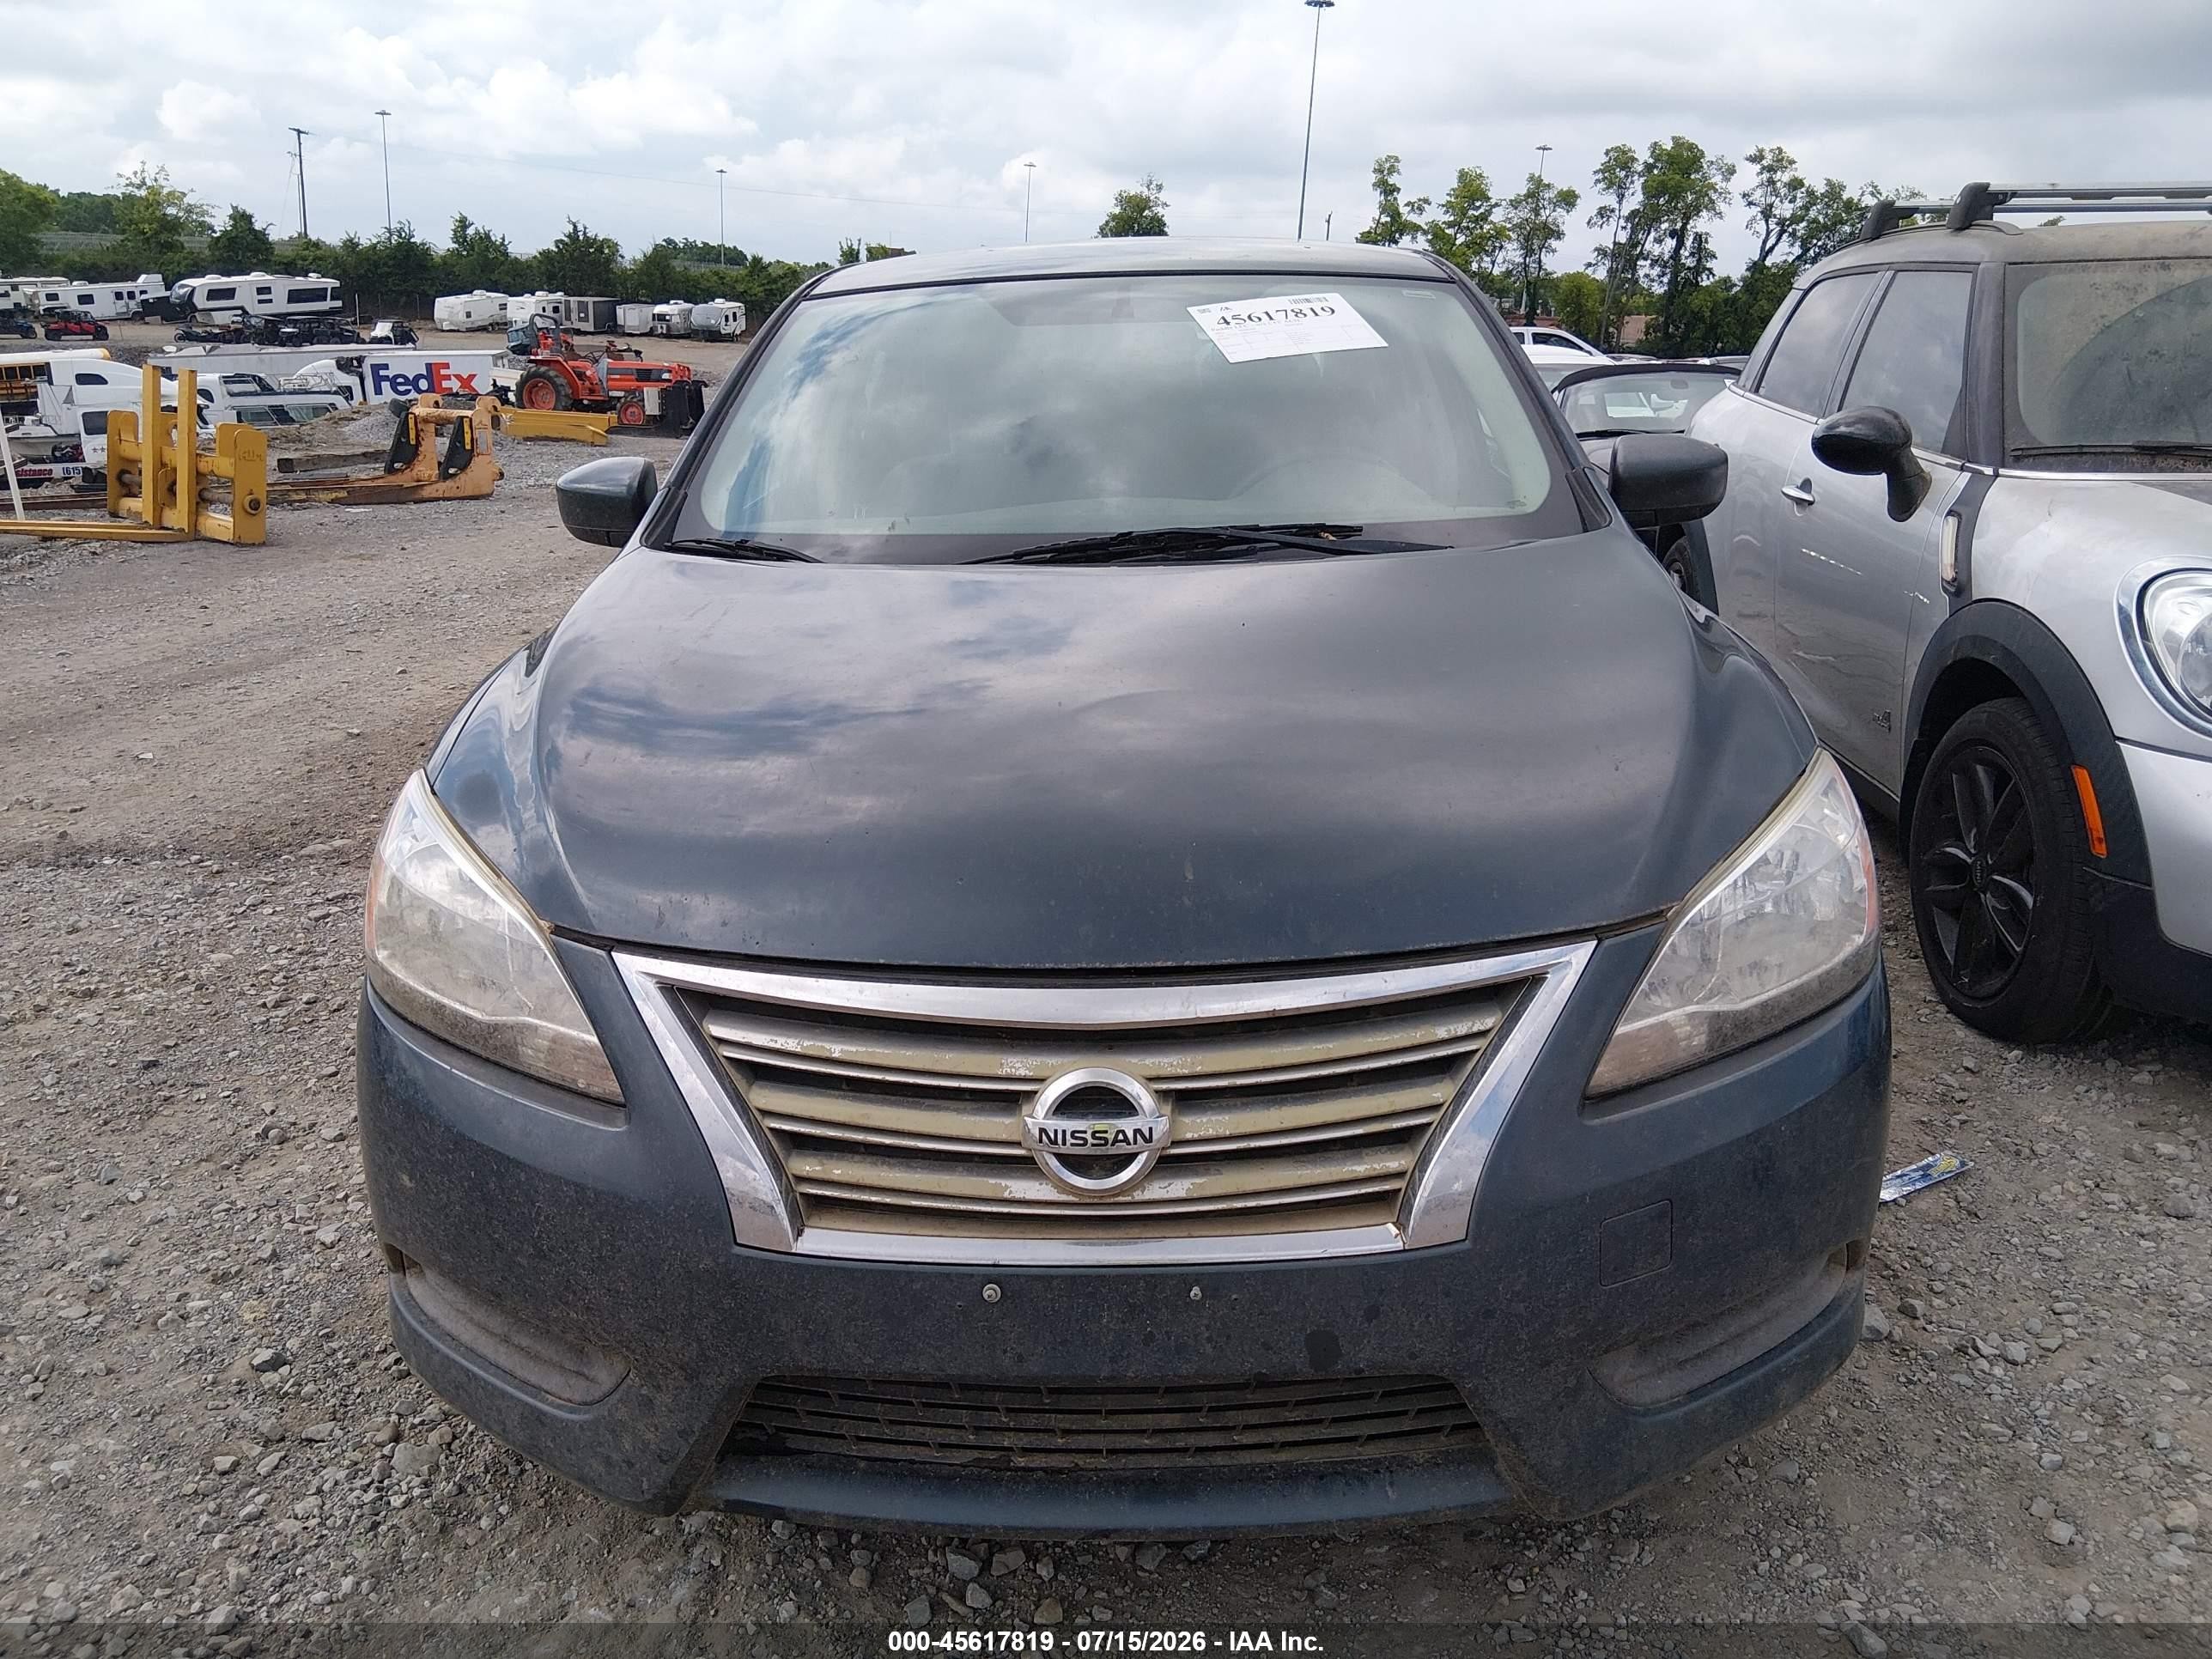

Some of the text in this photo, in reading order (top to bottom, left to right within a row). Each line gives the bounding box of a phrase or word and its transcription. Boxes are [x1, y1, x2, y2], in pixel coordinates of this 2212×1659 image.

[1217, 306, 1336, 326] 45617819
[370, 362, 480, 397] FedEx
[1038, 1126, 1153, 1147] NISSAN
